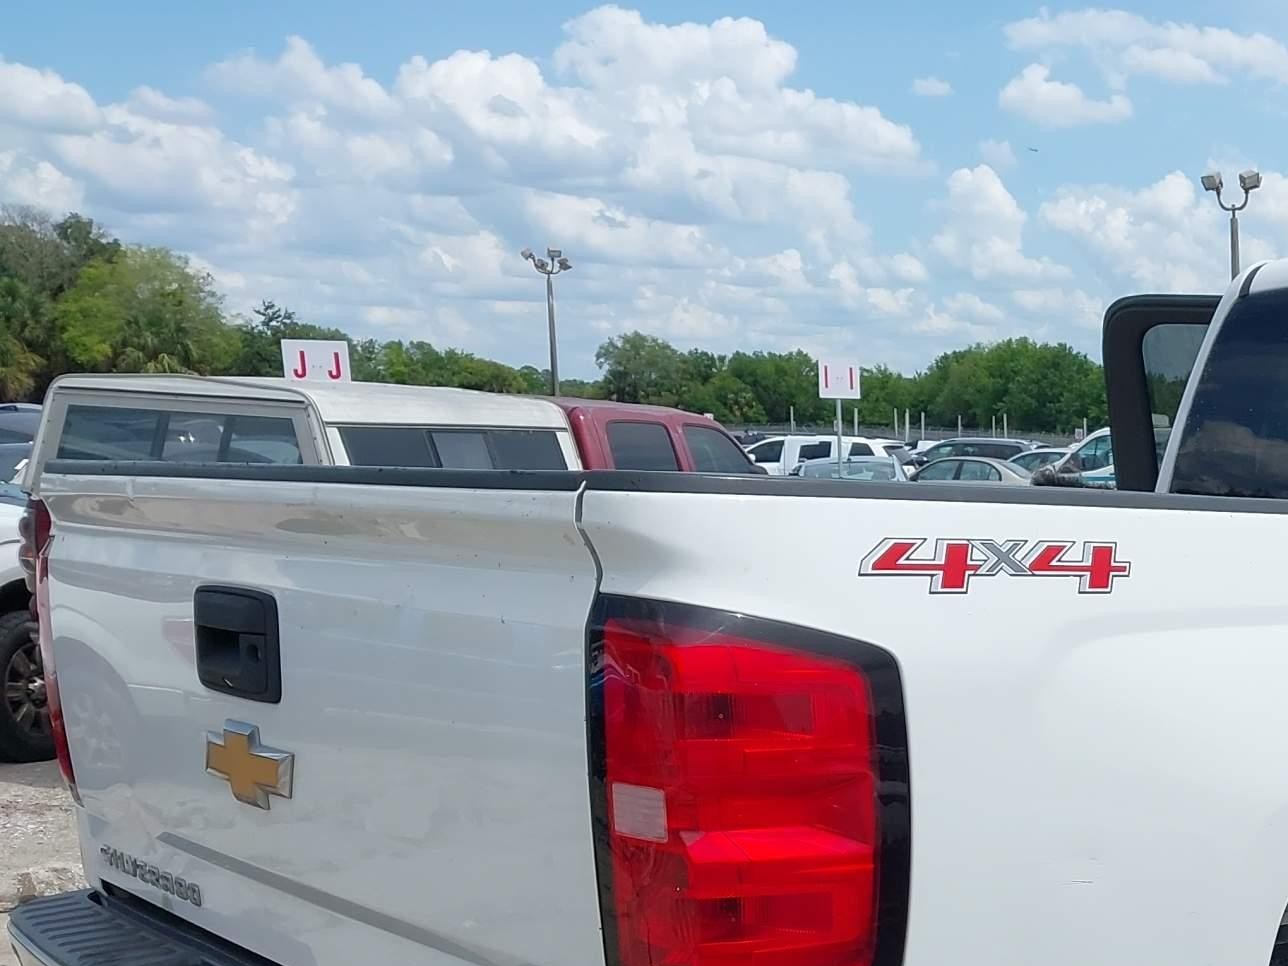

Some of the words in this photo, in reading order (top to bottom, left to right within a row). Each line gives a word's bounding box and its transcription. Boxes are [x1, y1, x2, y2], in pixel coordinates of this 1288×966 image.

[293, 350, 307, 379] J
[327, 351, 342, 380] J
[99, 843, 203, 908] SILVERADO
